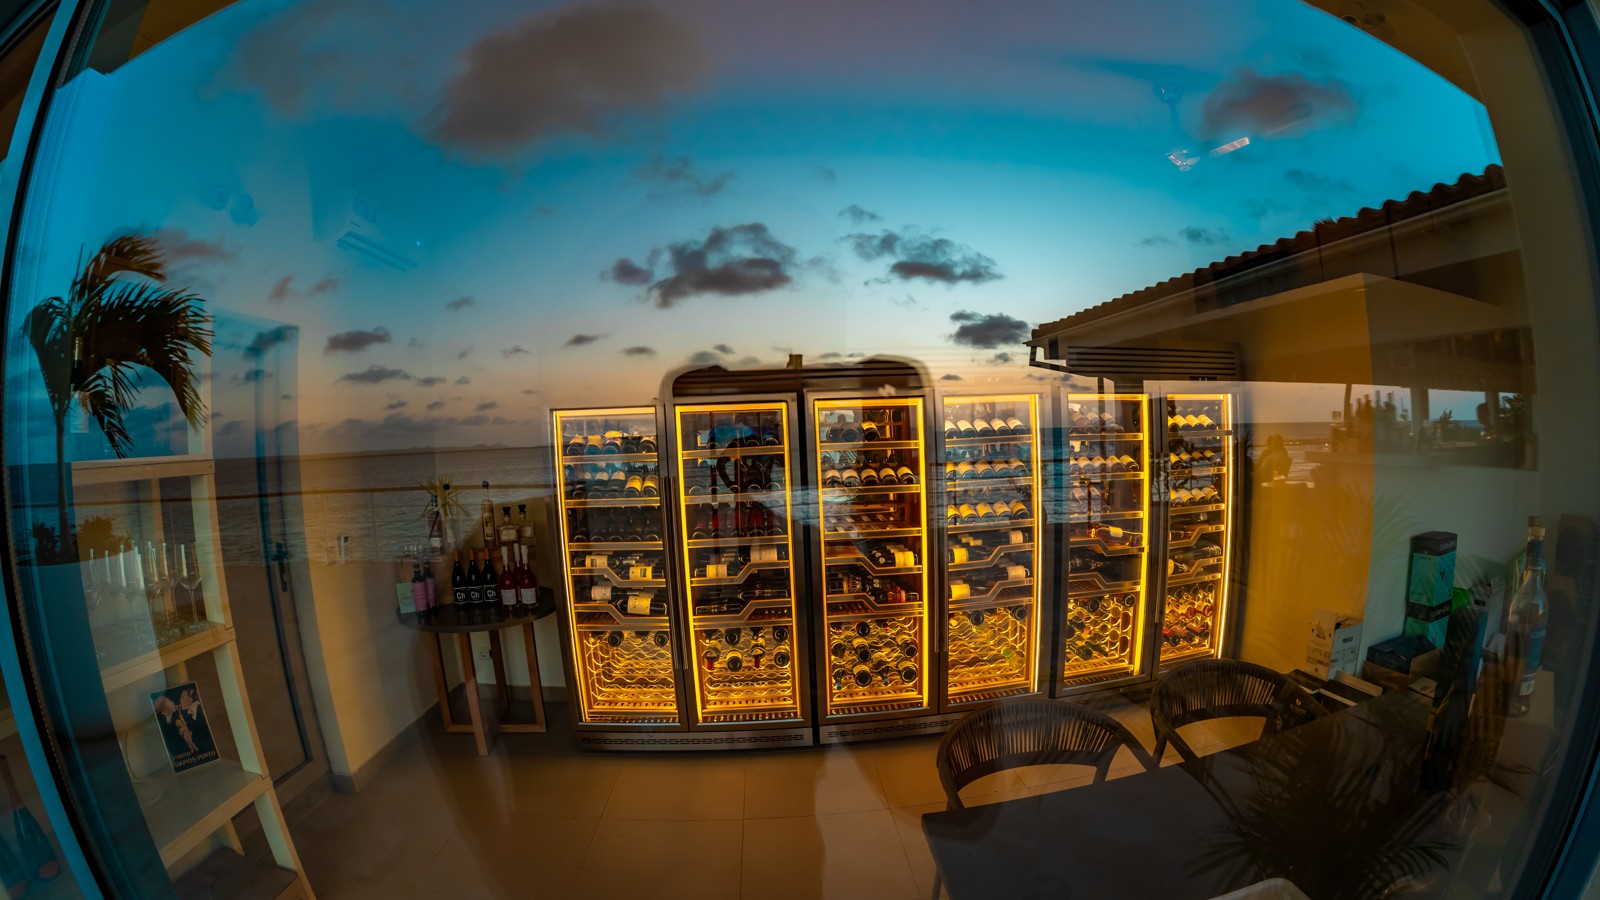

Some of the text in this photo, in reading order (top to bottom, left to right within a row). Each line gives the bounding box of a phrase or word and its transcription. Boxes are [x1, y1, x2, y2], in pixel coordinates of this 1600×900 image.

[456, 592, 466, 600] Ch
[470, 591, 480, 599] Ch
[487, 589, 496, 597] Ch
